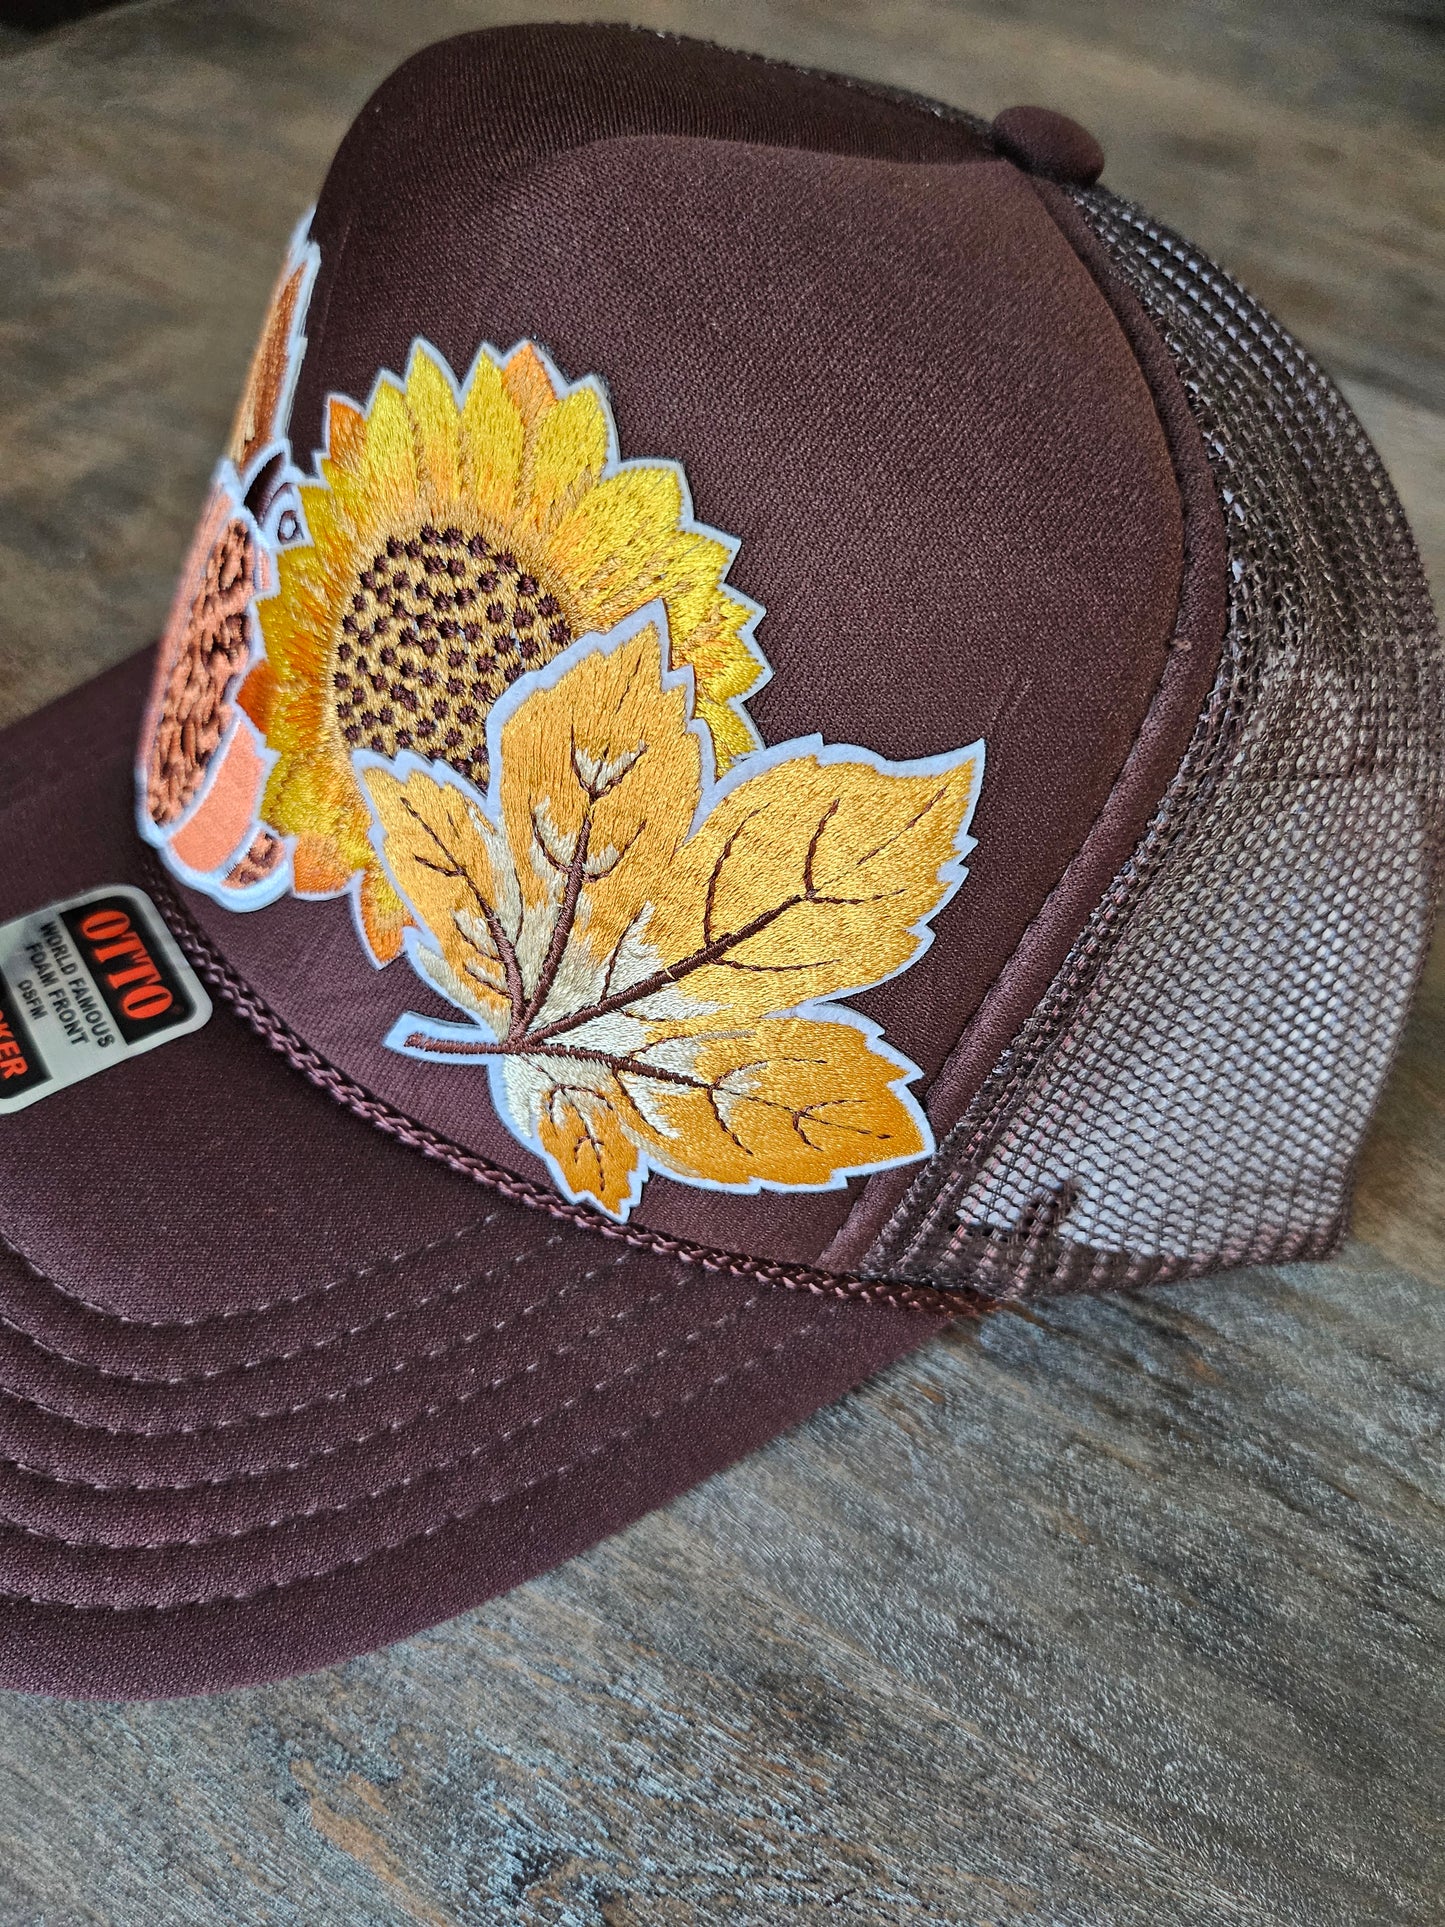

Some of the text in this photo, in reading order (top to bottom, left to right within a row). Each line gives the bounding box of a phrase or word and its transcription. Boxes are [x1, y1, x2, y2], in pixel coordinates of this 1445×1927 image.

[18, 980, 47, 1020] OSFM
[25, 943, 90, 1045] FOAM FRONT
[41, 923, 115, 1047] WORLD FAMOUS
[82, 911, 172, 1018] OTTO
